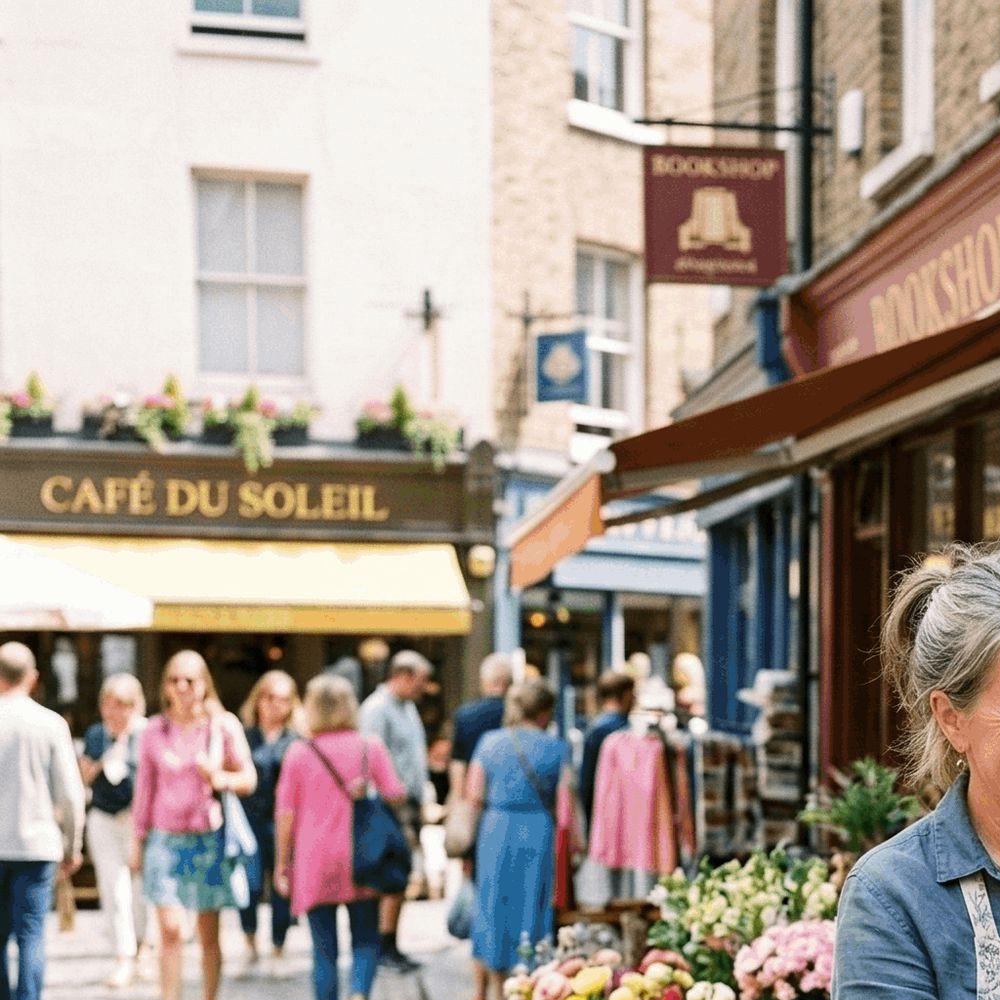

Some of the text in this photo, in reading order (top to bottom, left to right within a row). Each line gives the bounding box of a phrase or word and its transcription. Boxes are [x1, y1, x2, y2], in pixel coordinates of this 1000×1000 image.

[40, 470, 390, 522] CAFÉ DU SOLEIL
